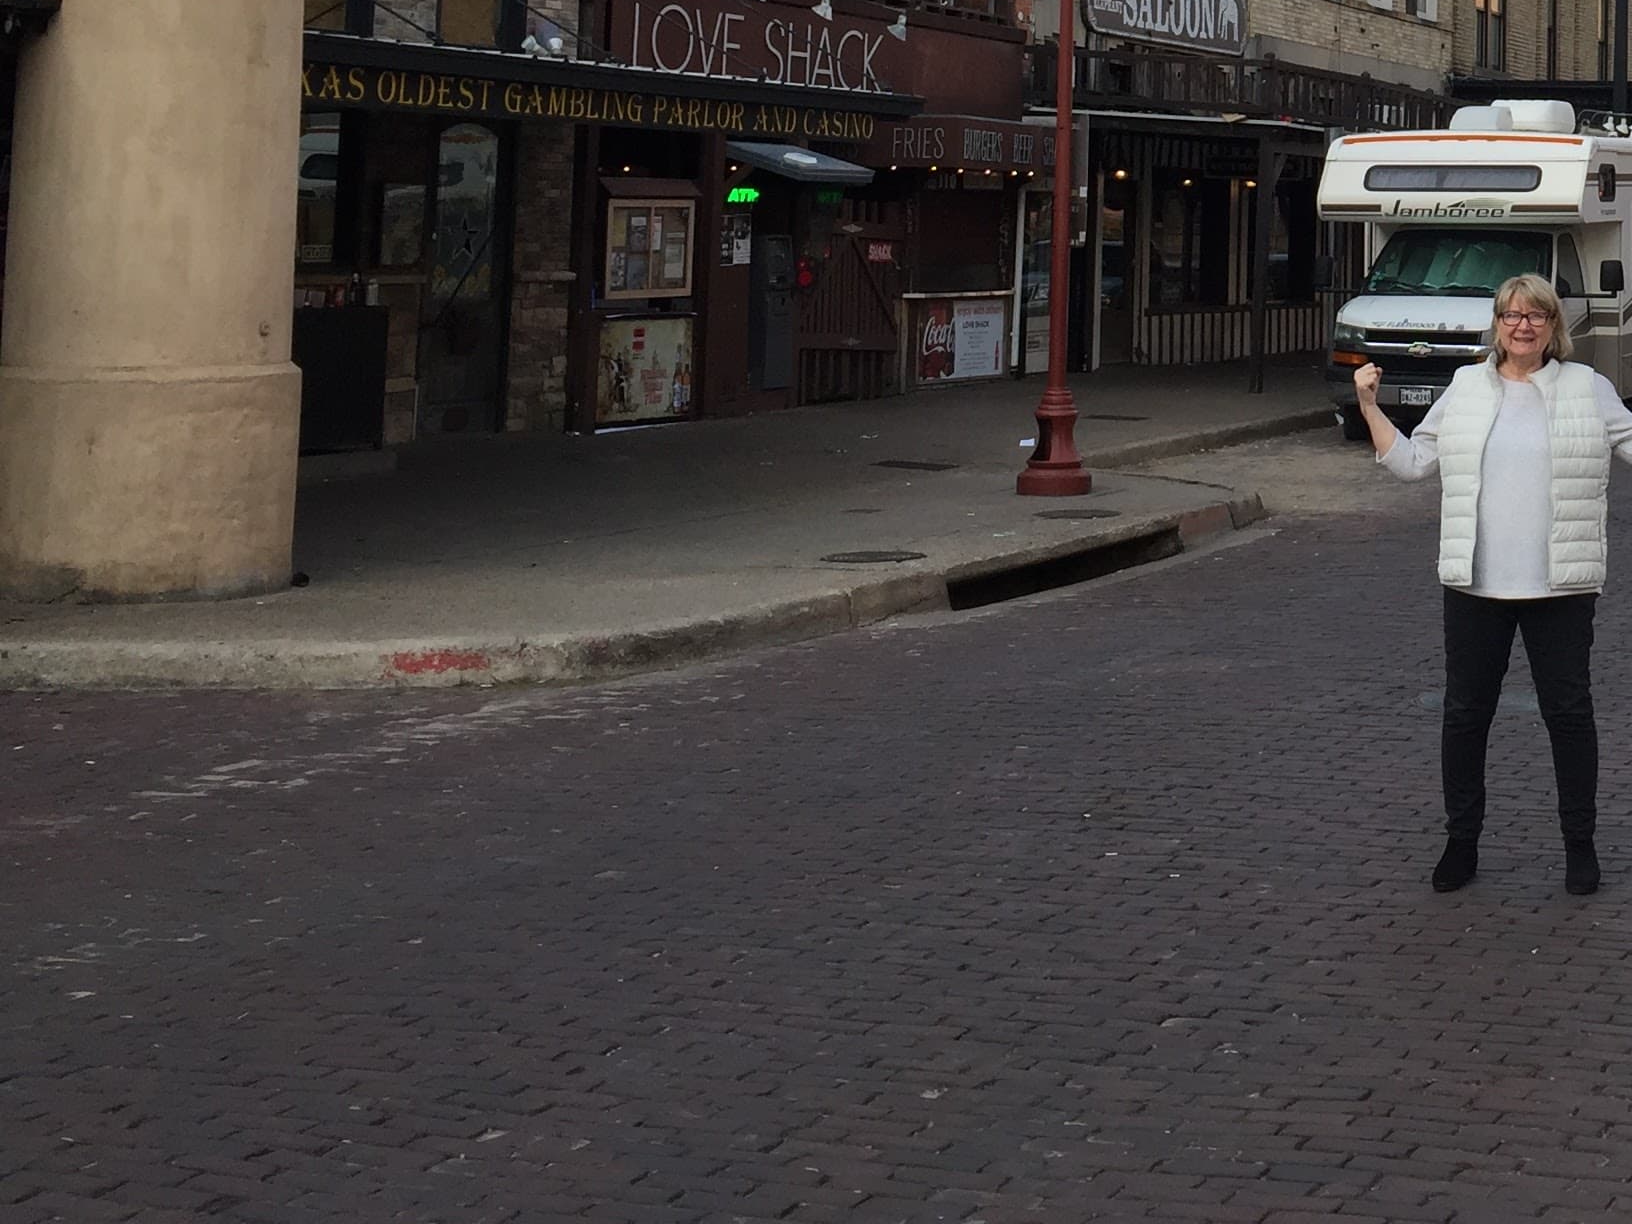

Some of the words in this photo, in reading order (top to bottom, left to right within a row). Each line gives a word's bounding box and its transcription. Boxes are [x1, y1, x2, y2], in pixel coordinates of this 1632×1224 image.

[632, 2, 745, 77] LOVE
[762, 19, 884, 93] SHACK
[377, 70, 495, 111] OLDEST
[504, 81, 642, 123] GAMBLING
[653, 96, 745, 131] PARLOR
[753, 105, 797, 133] AND
[803, 109, 874, 140] CASINO
[892, 127, 945, 160] FRIES
[963, 128, 1003, 163] BURGERS
[1013, 134, 1034, 164] BEER
[1384, 199, 1505, 219] Jamboree
